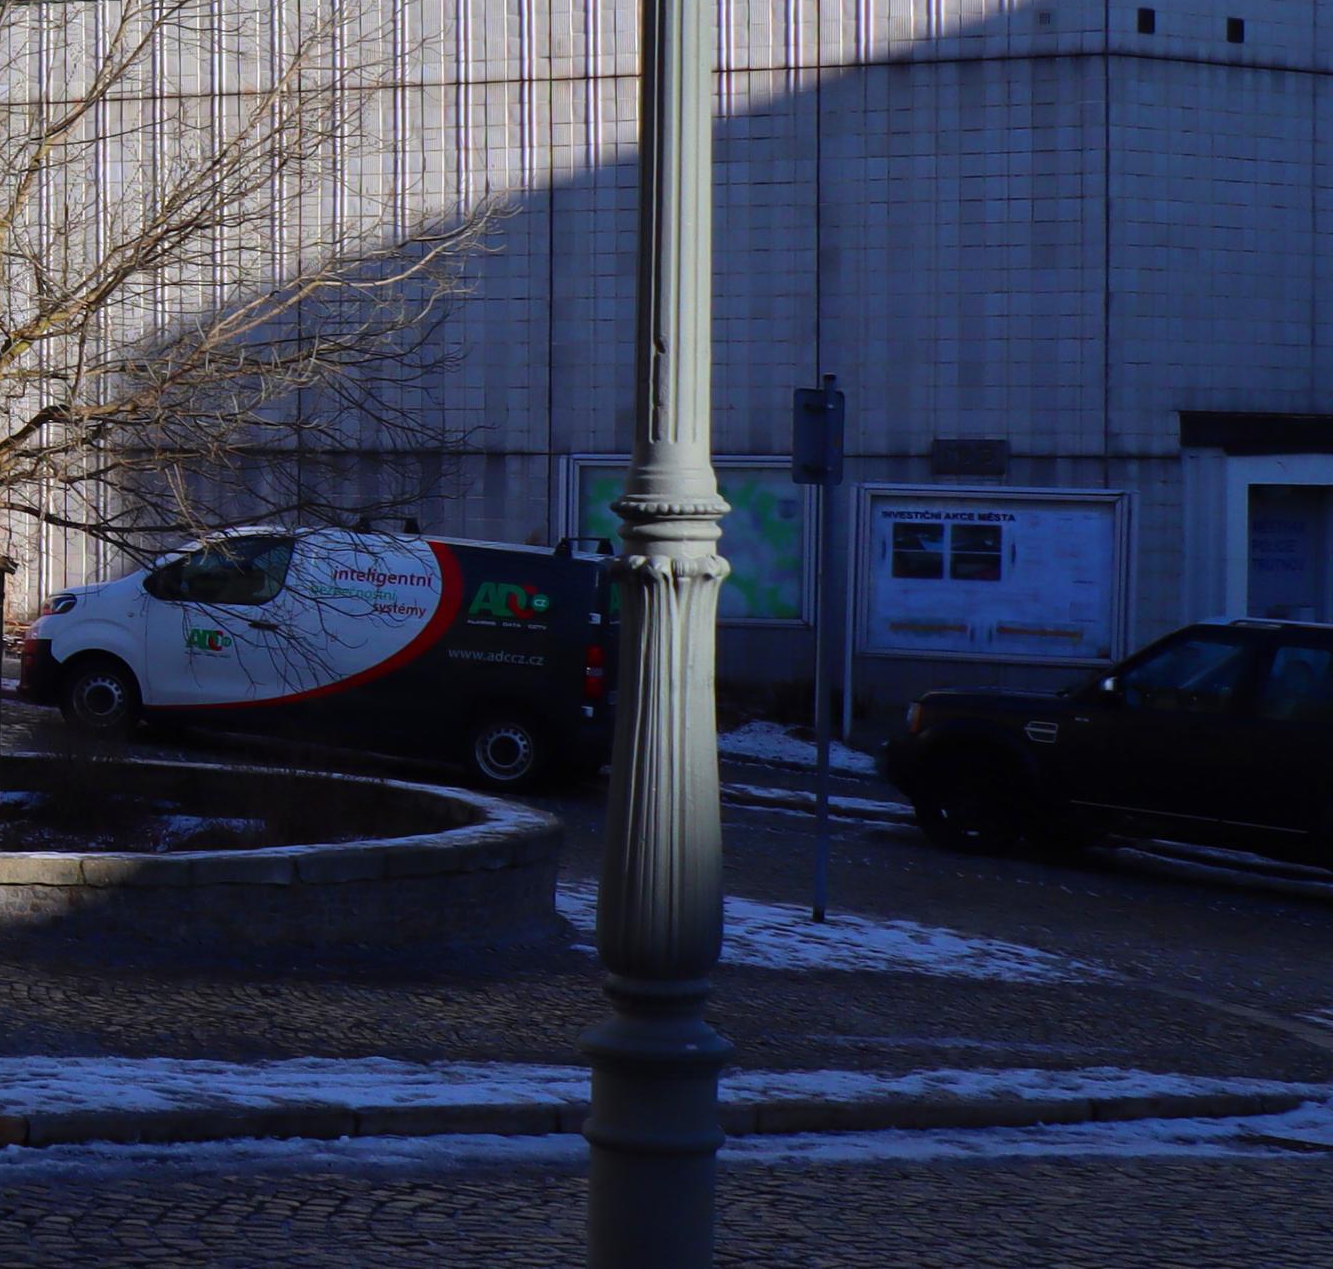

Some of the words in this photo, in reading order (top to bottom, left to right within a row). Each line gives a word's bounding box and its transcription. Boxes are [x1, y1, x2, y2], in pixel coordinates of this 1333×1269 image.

[944, 512, 975, 521] AKCE
[979, 512, 1016, 522] MĚSTA
[333, 565, 432, 587] inteligentní
[372, 603, 427, 618] systémy
[446, 648, 545, 666] www.adccz.cz
